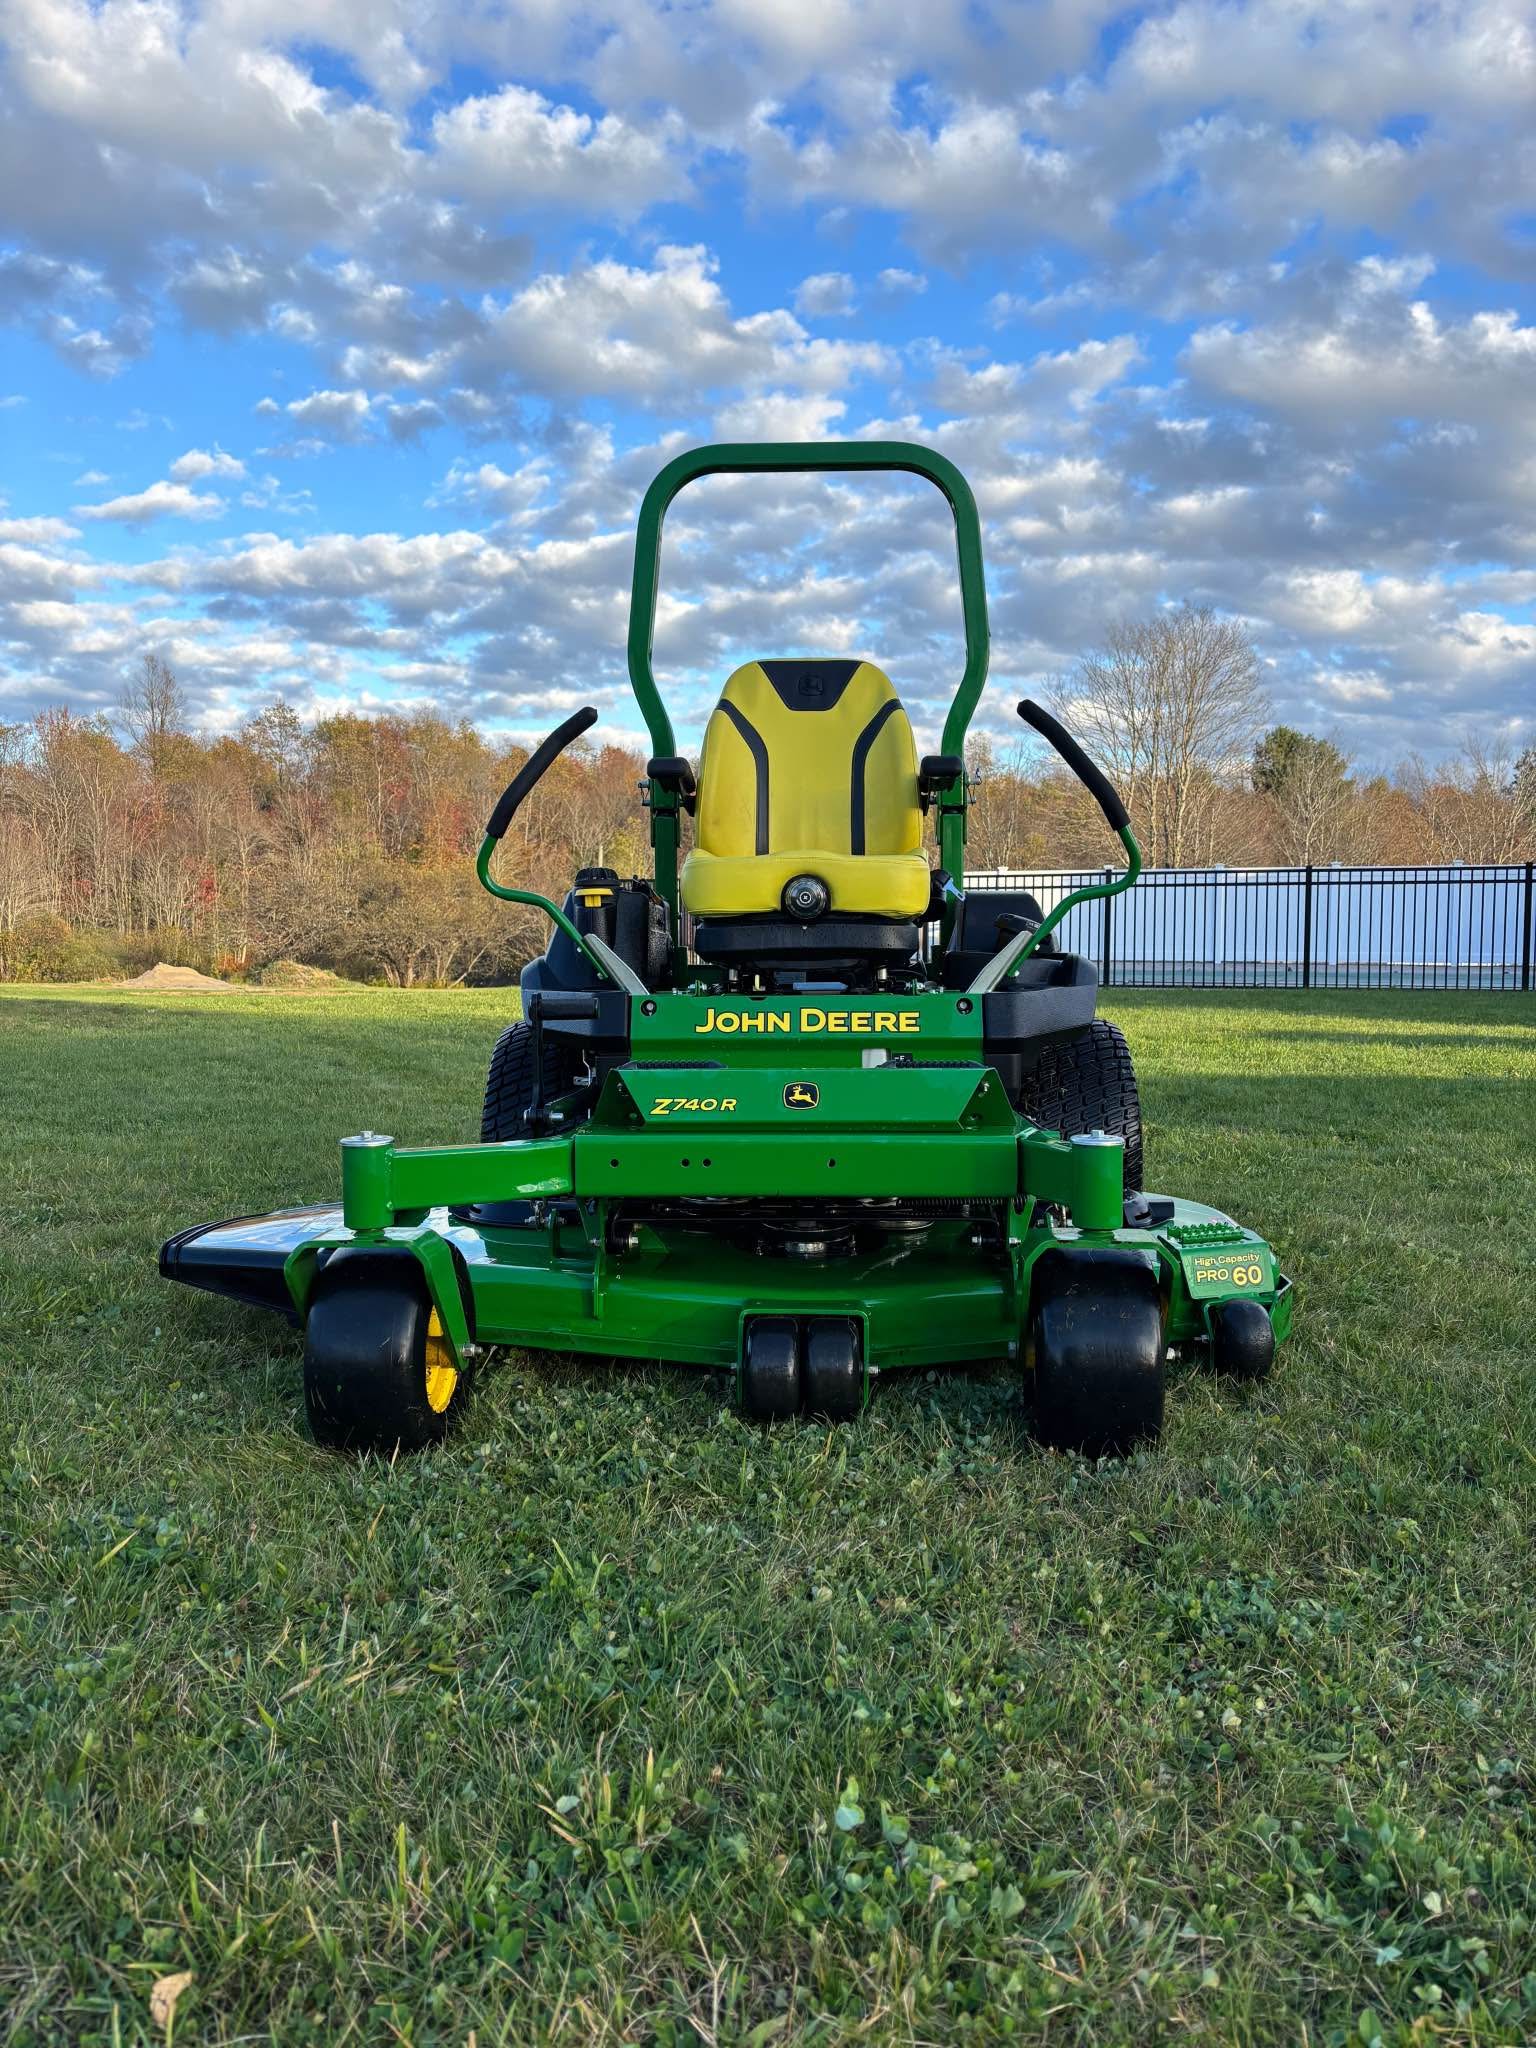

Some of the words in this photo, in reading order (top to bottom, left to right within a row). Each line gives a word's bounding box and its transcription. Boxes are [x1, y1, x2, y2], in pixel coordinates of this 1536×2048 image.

[695, 1008, 791, 1033] JOHN
[800, 1008, 920, 1033] DEERE
[1195, 1257, 1216, 1266] High
[1218, 1253, 1260, 1264] Capacity
[1196, 1269, 1229, 1283] PRO
[1232, 1265, 1262, 1286] 60
